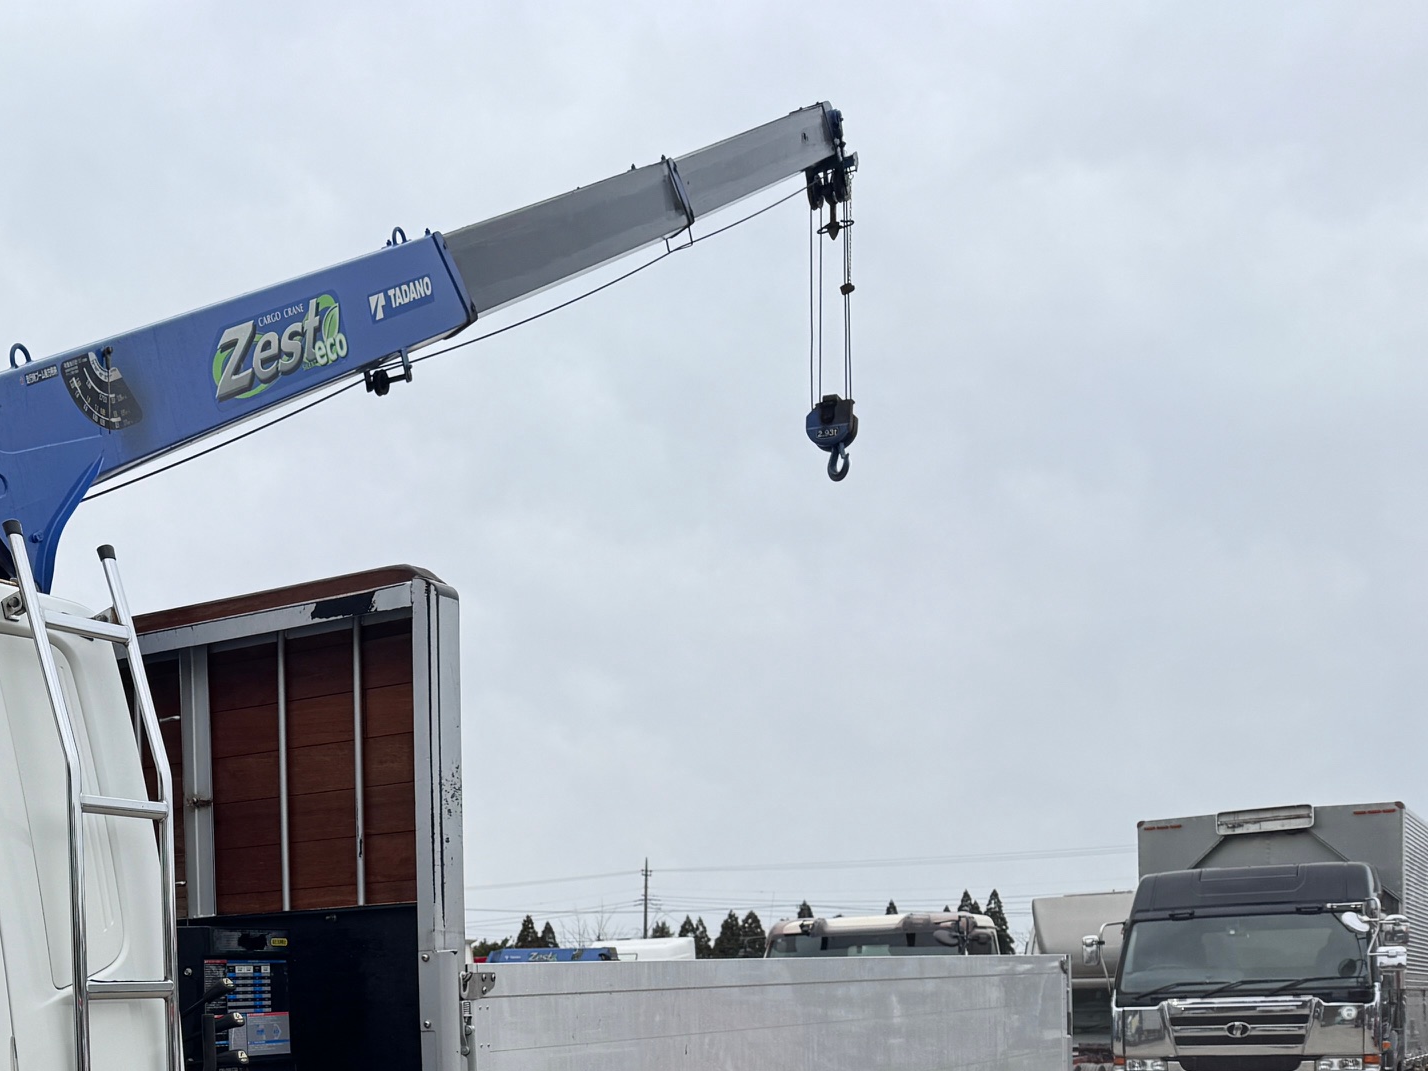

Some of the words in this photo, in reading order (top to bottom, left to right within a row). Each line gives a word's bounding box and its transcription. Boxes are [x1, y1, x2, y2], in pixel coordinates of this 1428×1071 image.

[387, 276, 432, 308] TADANO
[258, 312, 281, 327] CARGO
[283, 303, 304, 319] CRANE
[217, 298, 320, 402] Zest
[315, 331, 348, 366] eco
[817, 429, 837, 437] 2.93t
